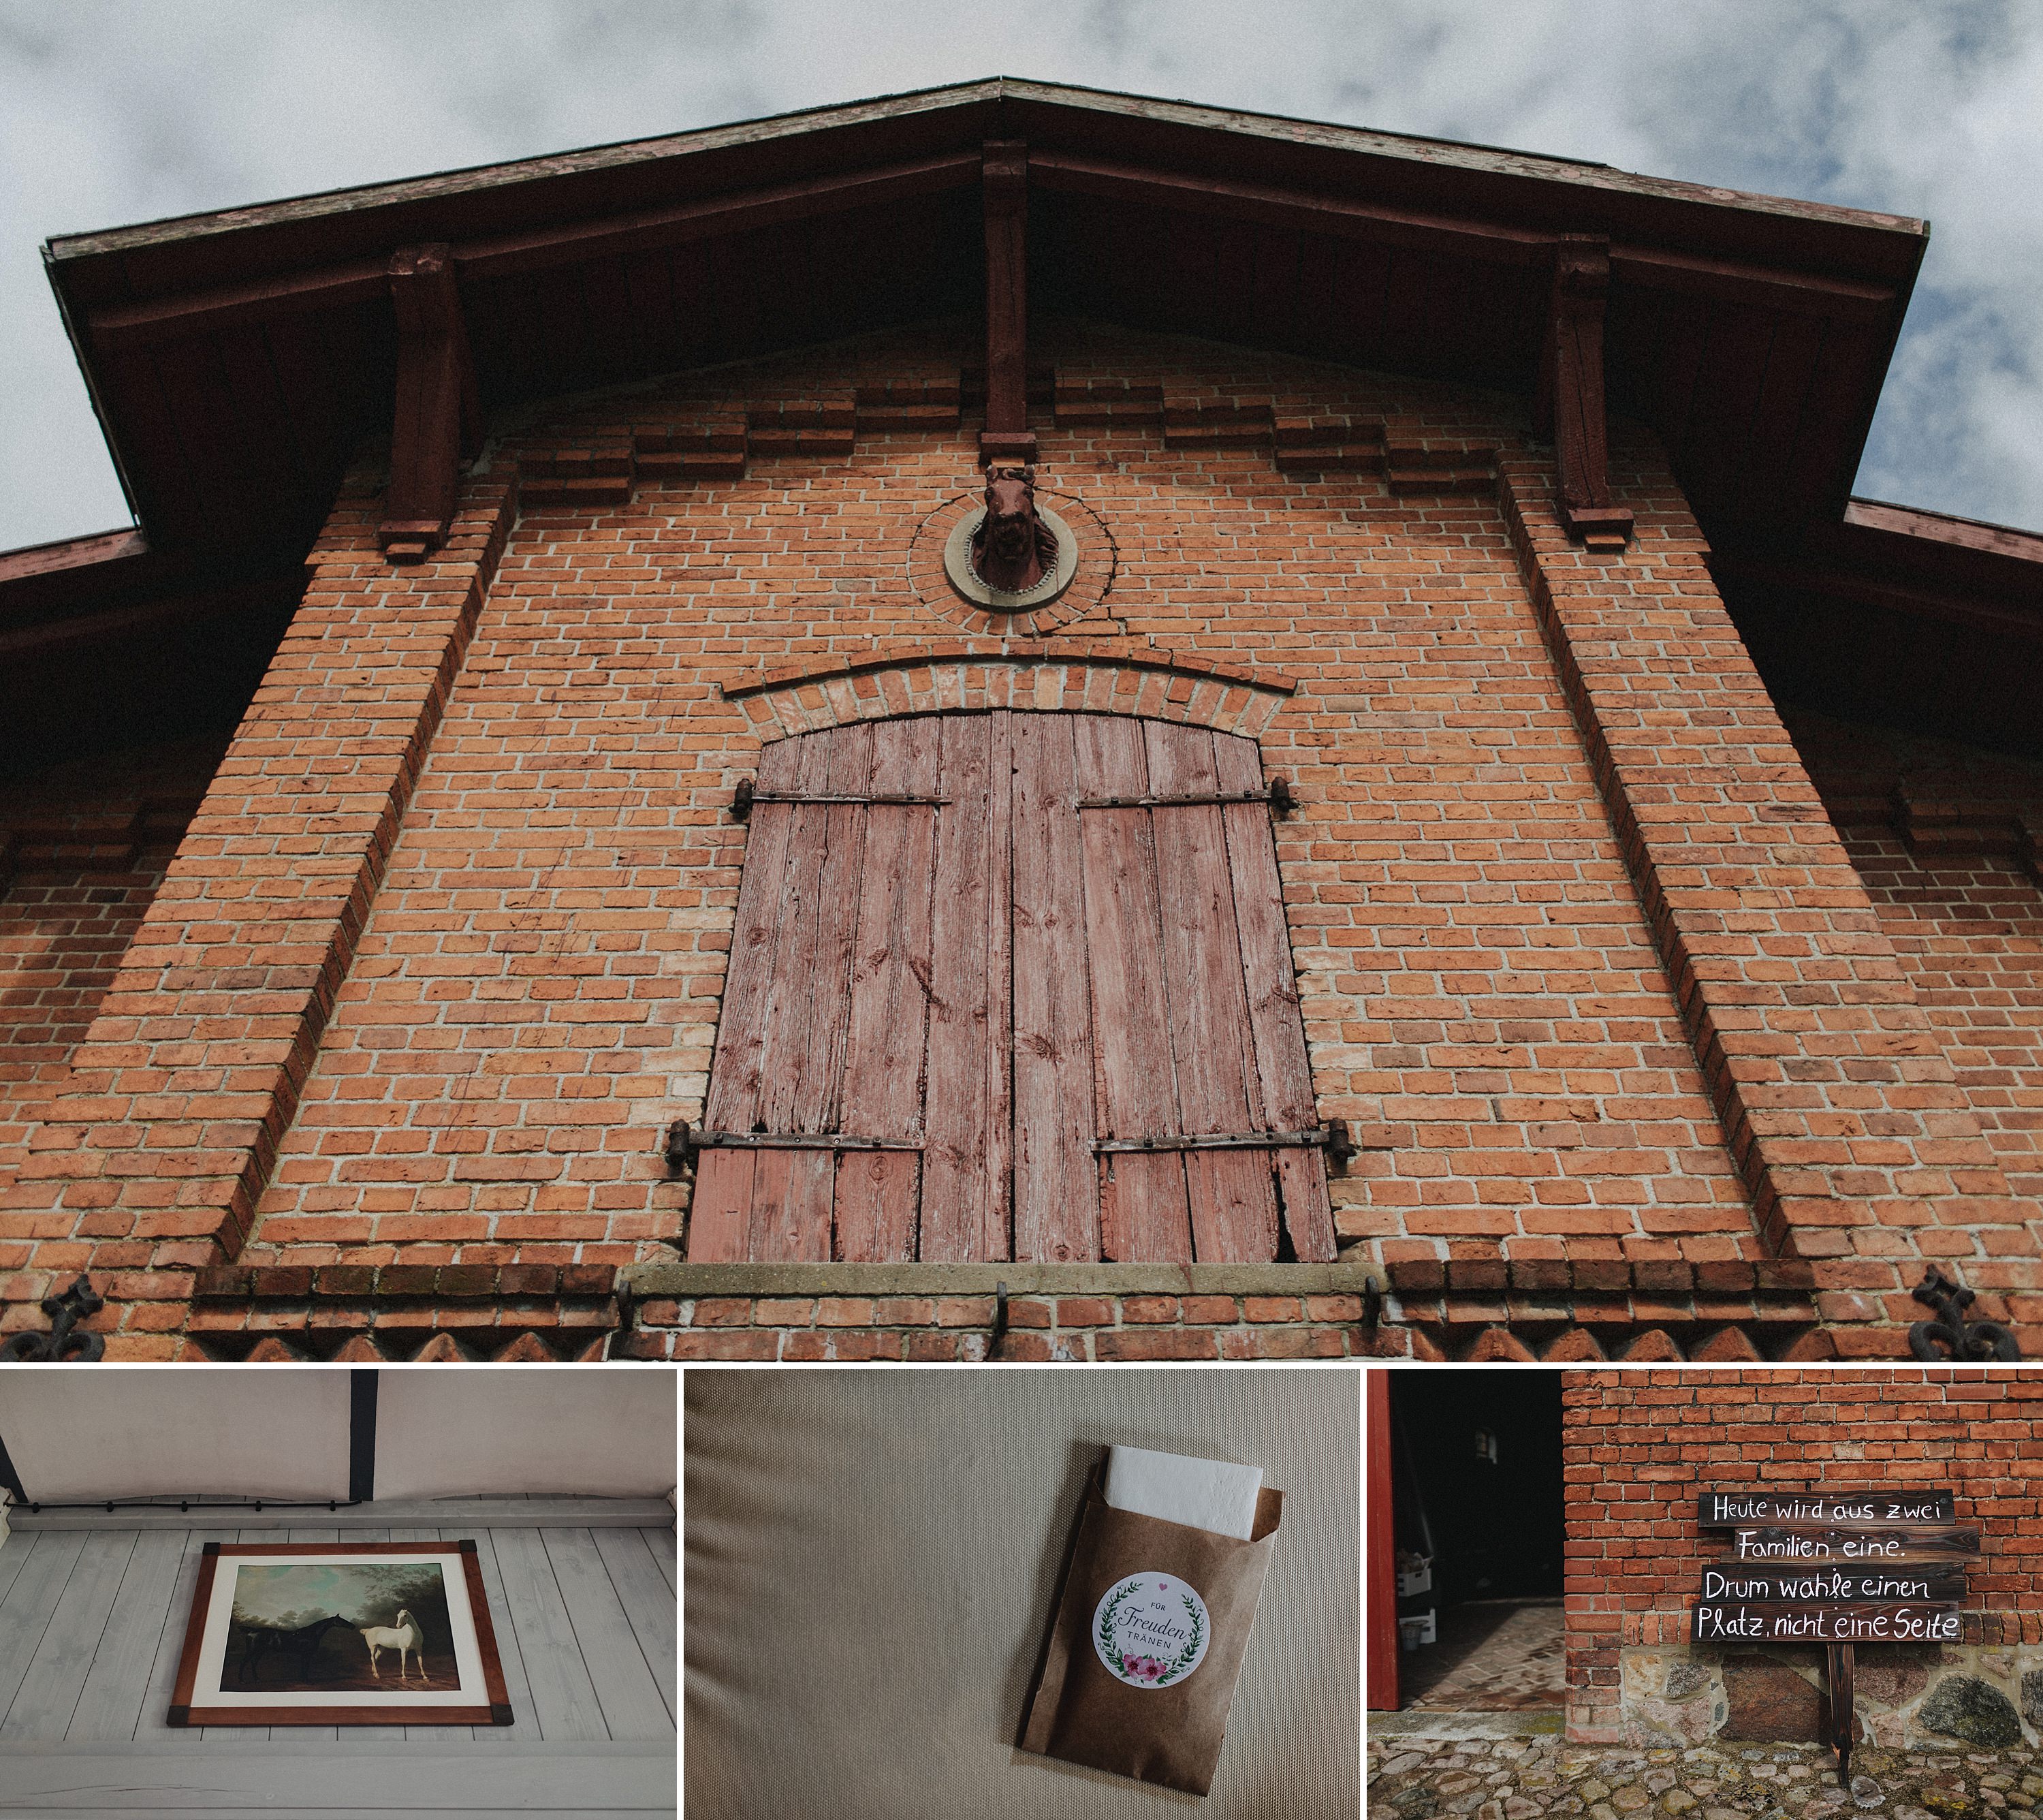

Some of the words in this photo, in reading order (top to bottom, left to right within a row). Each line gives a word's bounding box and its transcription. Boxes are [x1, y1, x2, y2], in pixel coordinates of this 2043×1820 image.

[1713, 1495, 1767, 1521] Heute
[1776, 1499, 1823, 1520] wird
[1832, 1504, 1874, 1520] aus
[1886, 1501, 1942, 1520] zwei
[1739, 1531, 1830, 1559] Familien
[1843, 1535, 1906, 1557] eine.
[1706, 1571, 1769, 1599] Drum
[1779, 1572, 1852, 1599] wähle
[1861, 1575, 1931, 1599] einen
[1150, 1602, 1166, 1611] FÜR
[1118, 1606, 1187, 1640] Freuden
[1698, 1606, 1770, 1639] Platz,
[1775, 1610, 1828, 1637] nicht
[1835, 1612, 1888, 1639] eine
[1893, 1608, 1959, 1639] Seite
[1127, 1631, 1171, 1649] TRÄNEN
